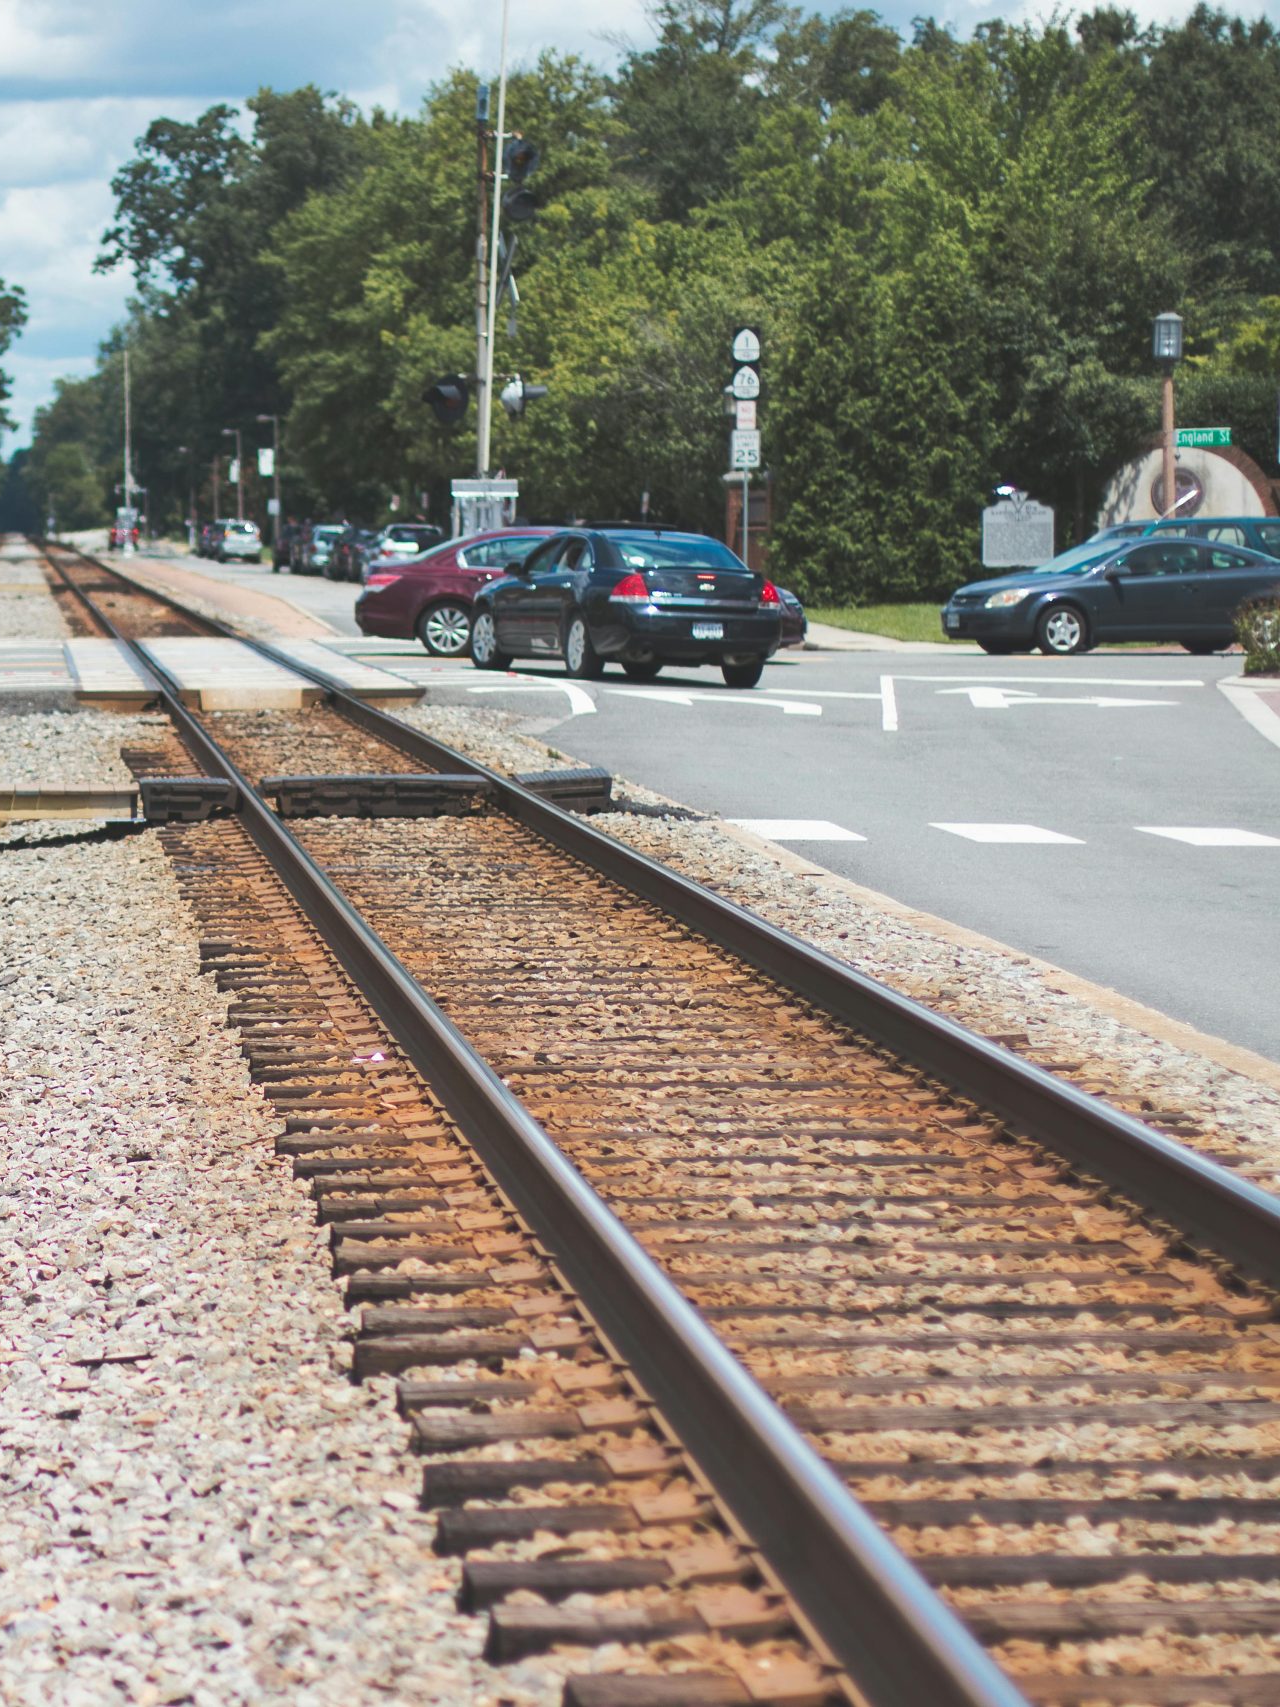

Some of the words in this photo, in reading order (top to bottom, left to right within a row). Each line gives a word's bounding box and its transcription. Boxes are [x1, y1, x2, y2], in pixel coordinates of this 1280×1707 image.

[744, 336, 749, 348] 1
[737, 373, 755, 385] 76
[1176, 431, 1214, 447] England
[1220, 430, 1230, 443] St
[736, 449, 758, 463] 25
